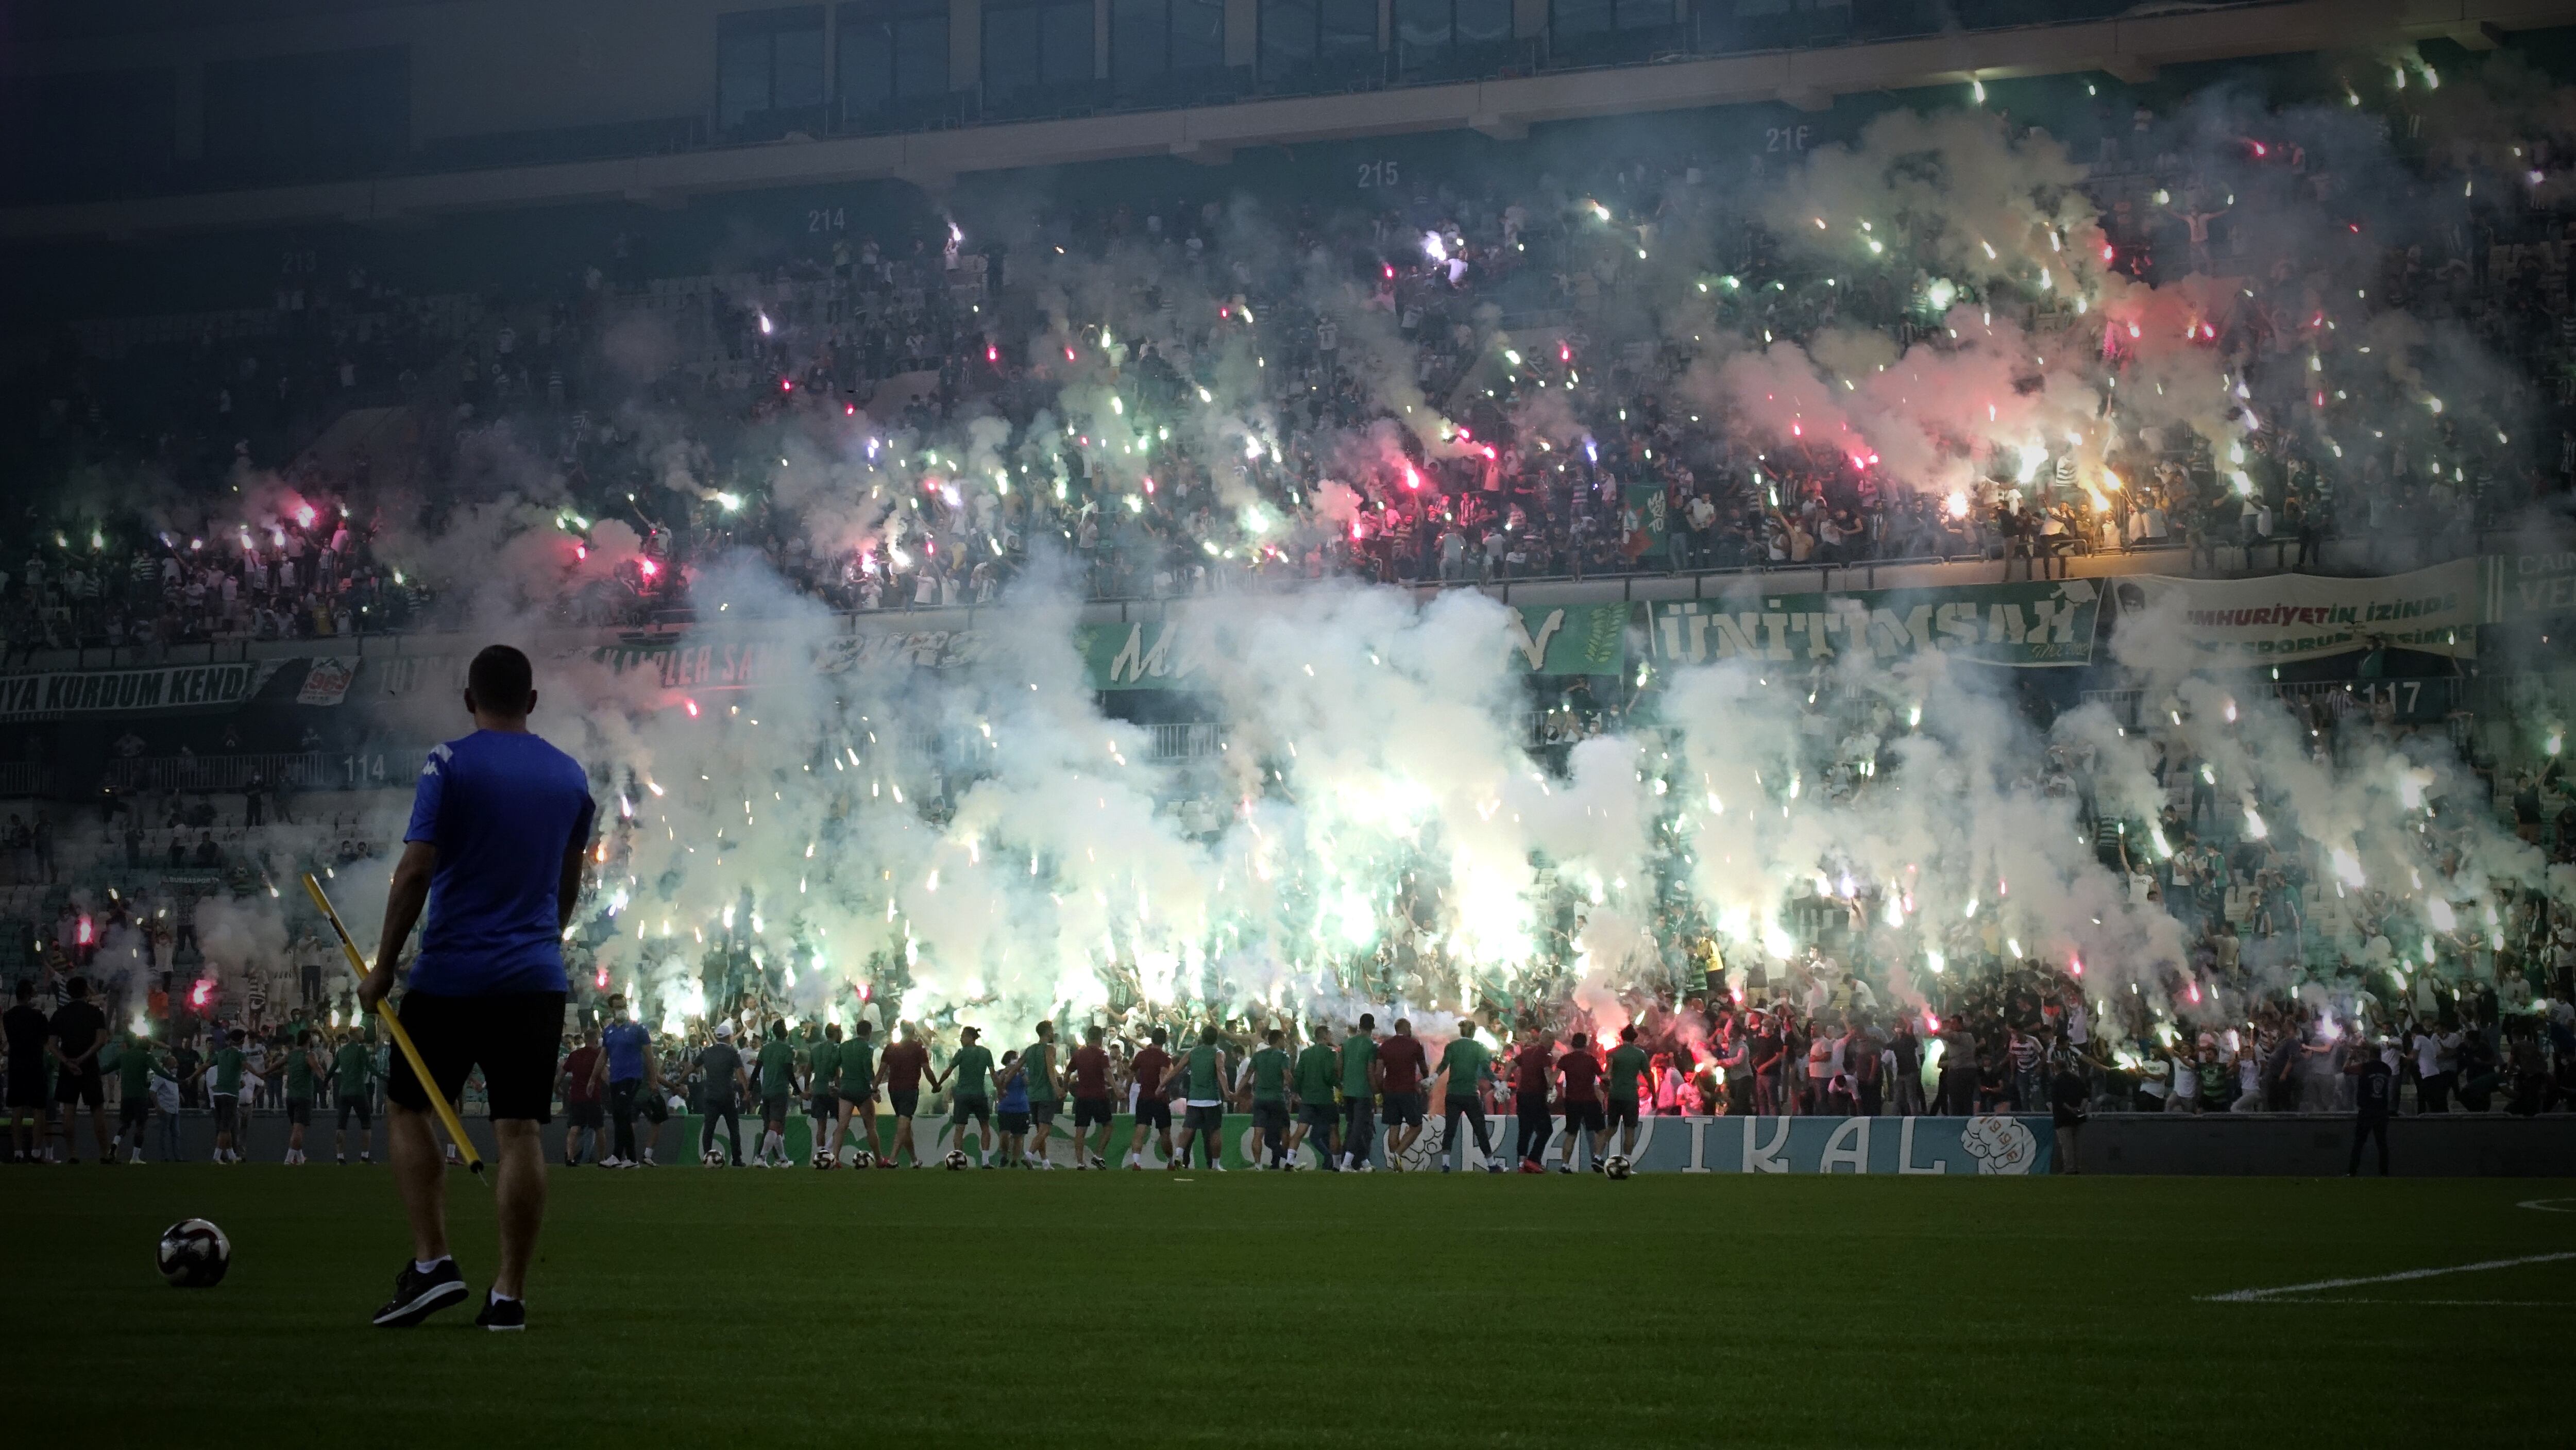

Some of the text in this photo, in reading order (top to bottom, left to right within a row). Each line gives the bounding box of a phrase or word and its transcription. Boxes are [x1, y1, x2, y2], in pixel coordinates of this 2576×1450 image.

[1358, 161, 1398, 188] 215
[808, 208, 845, 234] 214
[45, 673, 165, 710] KURDUM
[2362, 681, 2421, 714] 117
[344, 754, 385, 782] 114
